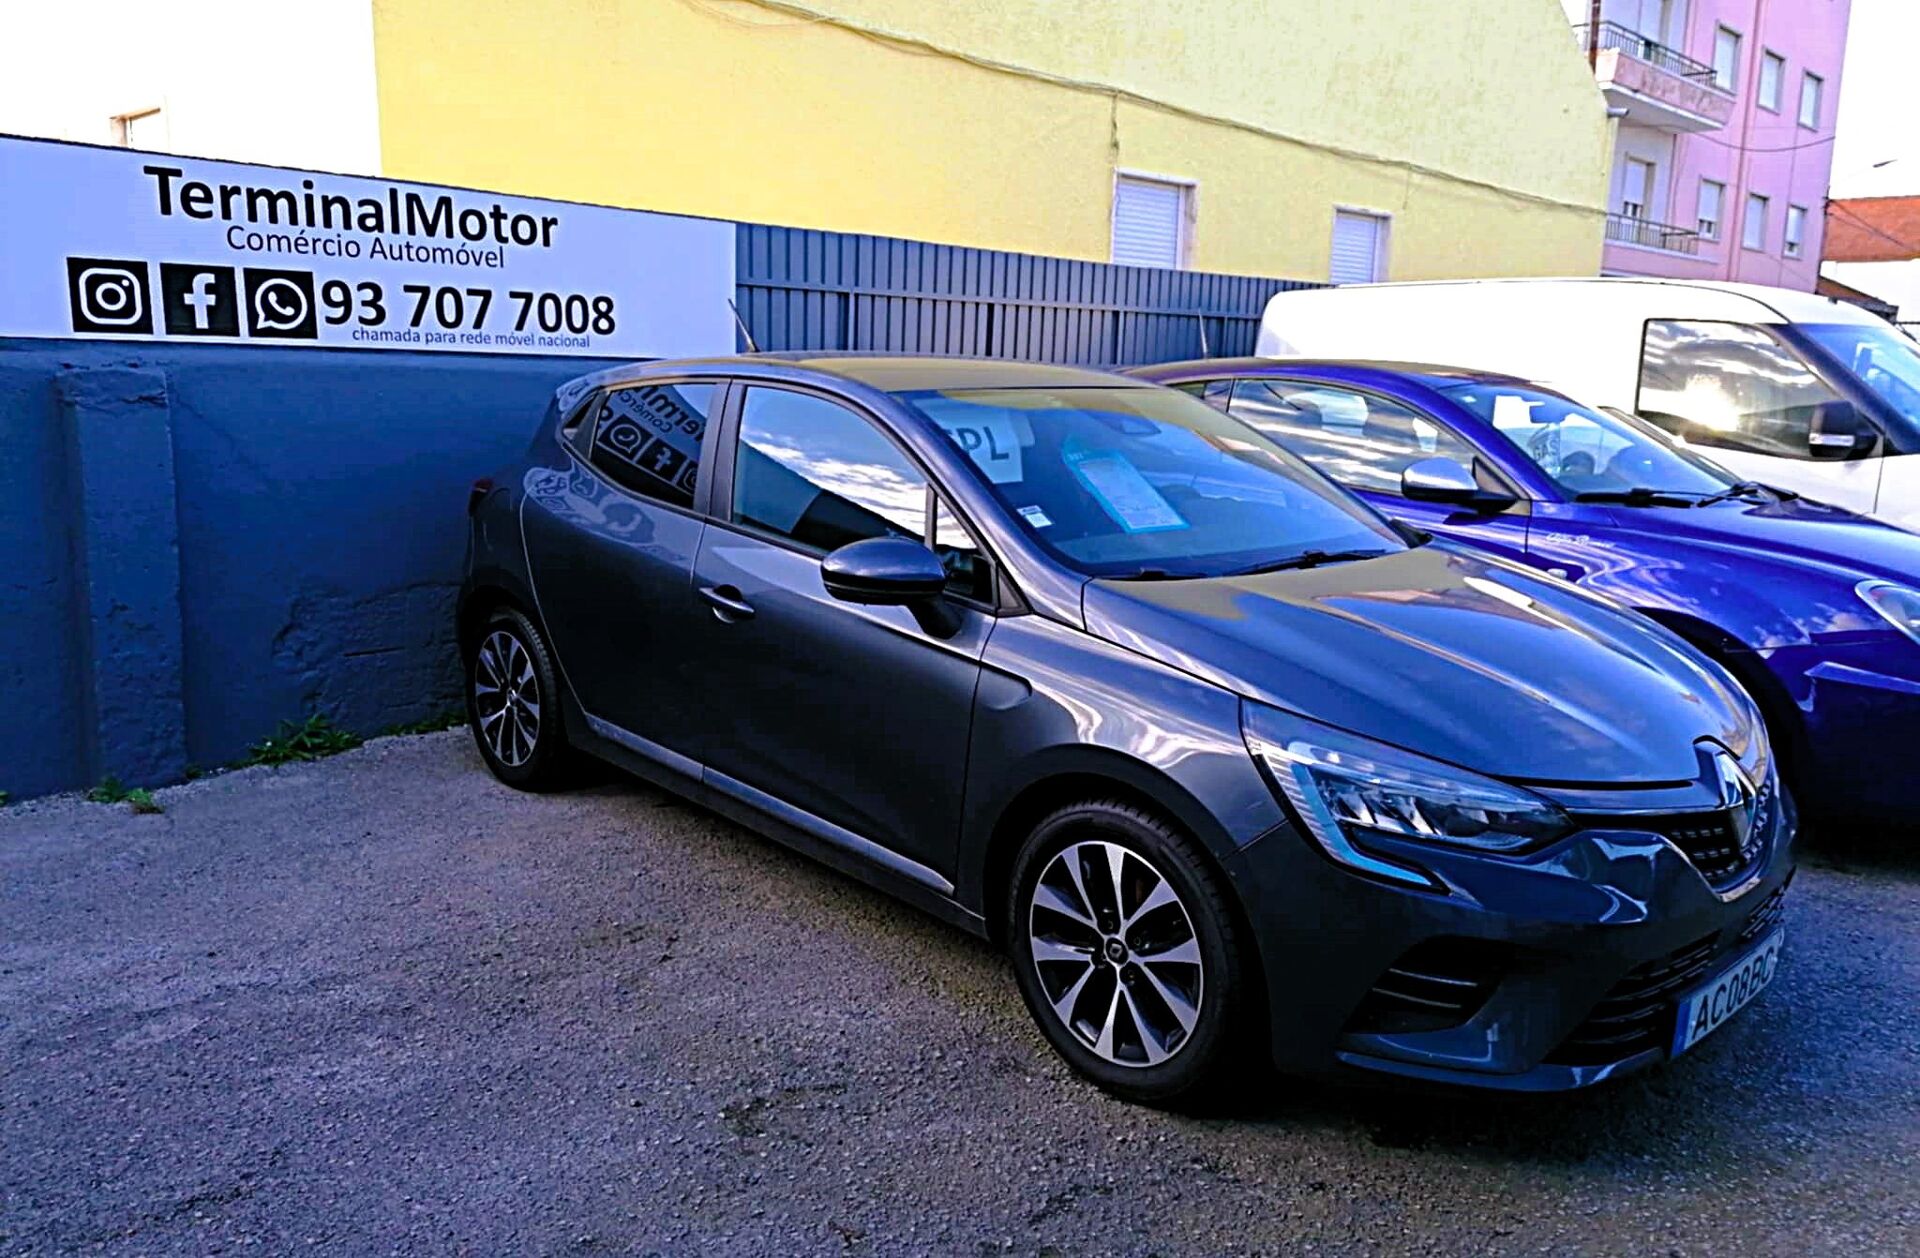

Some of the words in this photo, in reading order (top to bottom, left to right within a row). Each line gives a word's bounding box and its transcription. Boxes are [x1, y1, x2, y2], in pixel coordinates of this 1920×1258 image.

[143, 165, 558, 248] TerminalMotor
[227, 225, 361, 258] Comércio
[370, 236, 504, 268] Automóvel
[321, 279, 387, 326] 93
[403, 284, 492, 330] 707
[509, 291, 616, 335] 7008
[352, 326, 421, 342] chamada
[425, 332, 456, 344] para
[461, 332, 491, 345] rede
[495, 332, 535, 346] móvel
[538, 334, 590, 348] nacional
[943, 426, 1009, 461] PL
